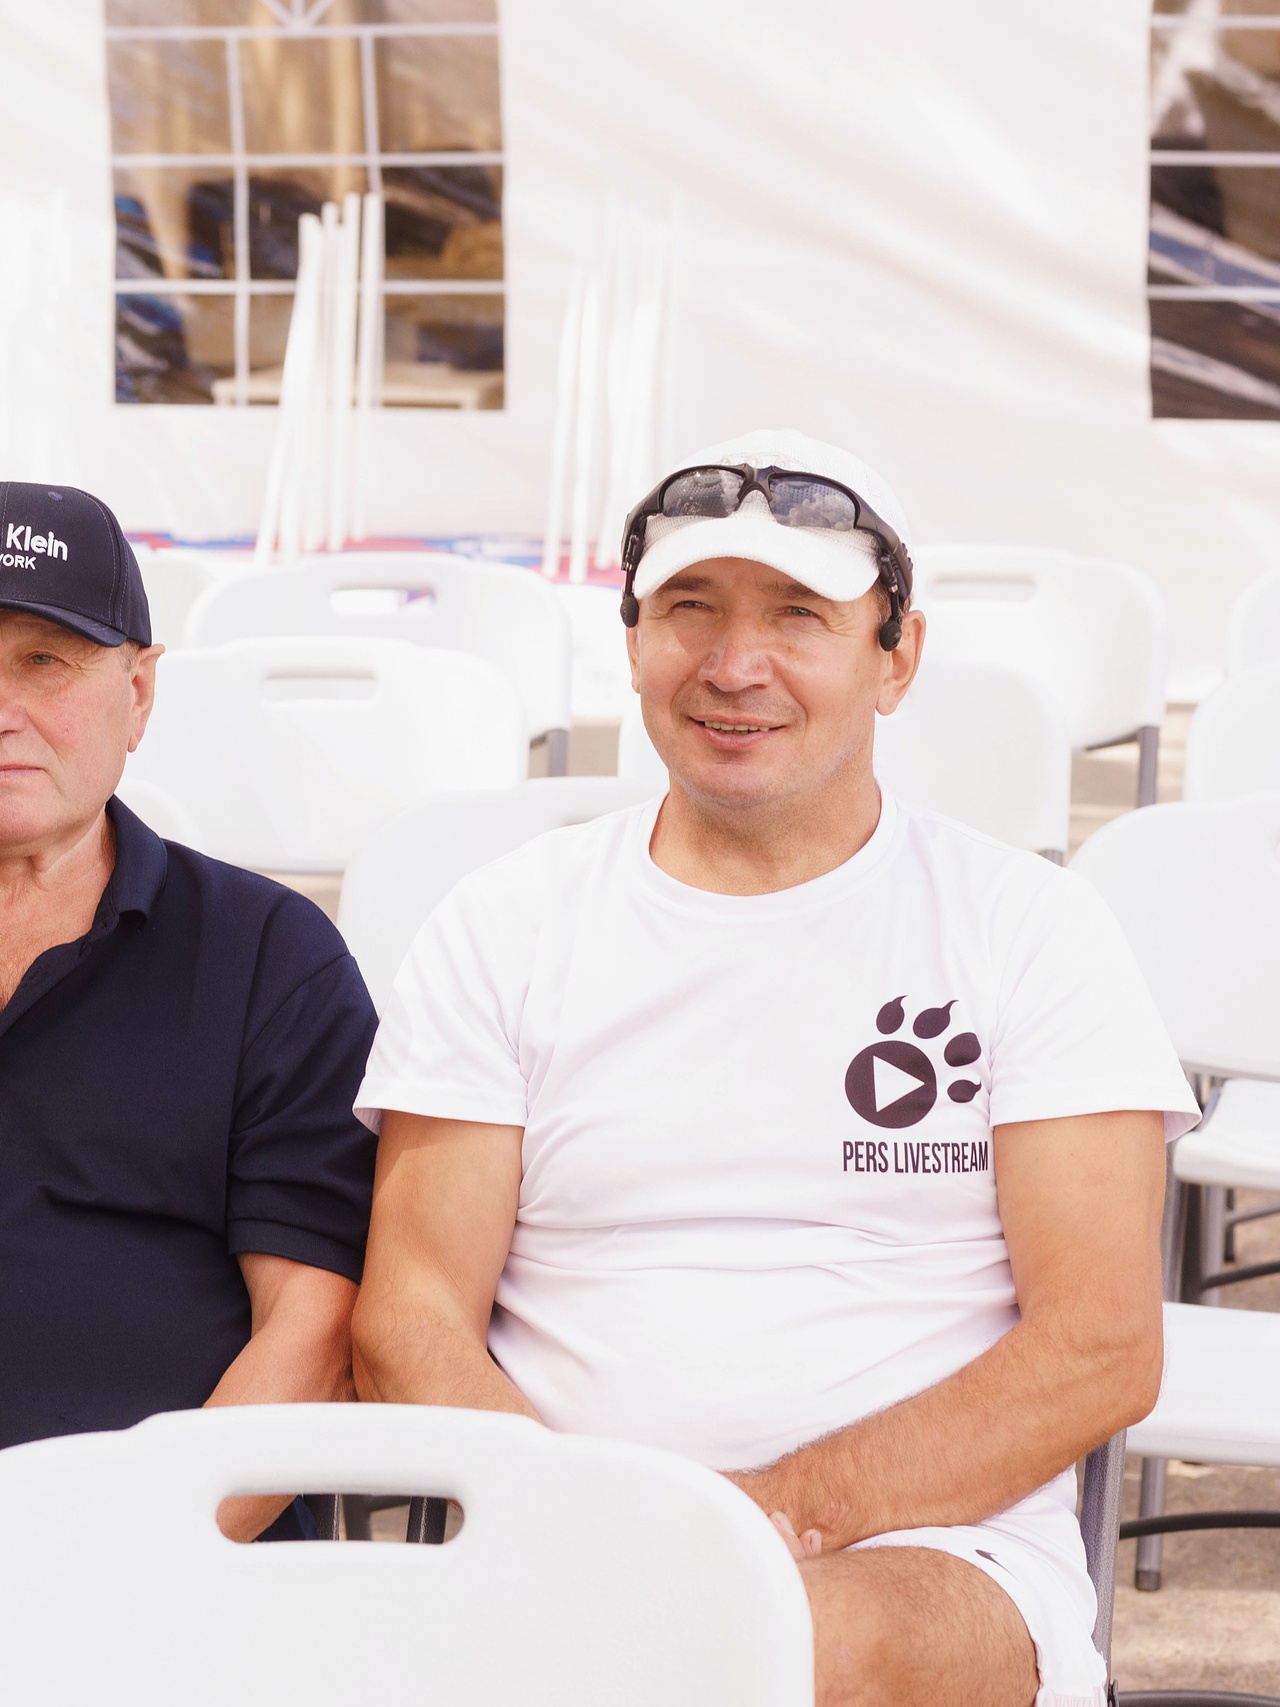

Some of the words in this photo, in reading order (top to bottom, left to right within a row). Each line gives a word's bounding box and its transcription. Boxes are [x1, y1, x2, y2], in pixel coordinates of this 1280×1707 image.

[6, 522, 68, 561] Klein
[843, 1141, 889, 1173] PERS
[893, 1141, 989, 1174] LIVESTREAM
